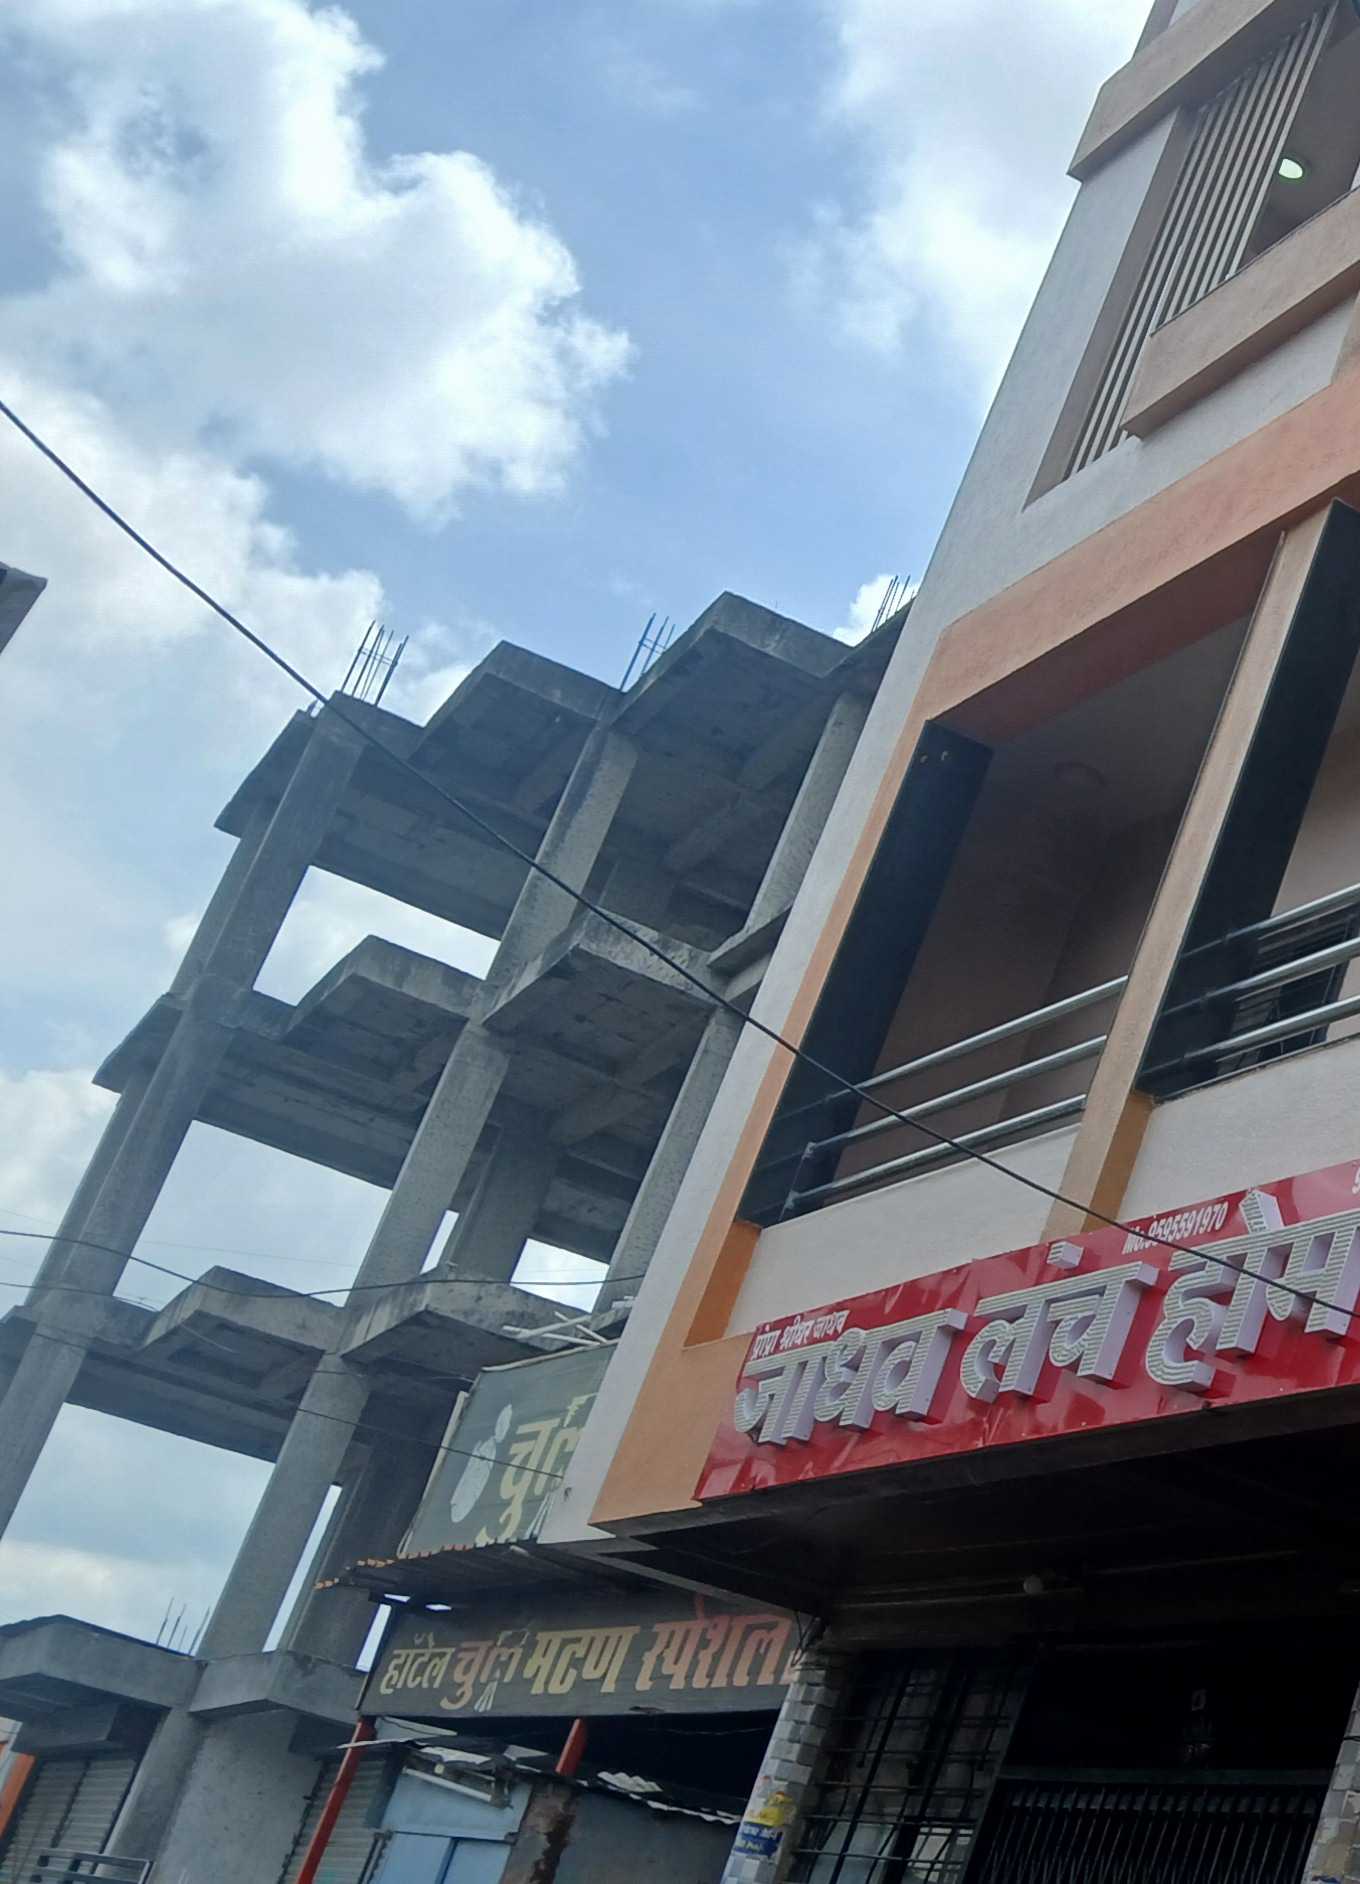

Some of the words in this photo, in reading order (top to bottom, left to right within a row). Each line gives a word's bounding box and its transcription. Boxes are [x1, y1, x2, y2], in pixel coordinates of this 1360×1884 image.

[734, 1308, 969, 1447] जाधव
[960, 1241, 1159, 1404] लंच
[380, 1632, 456, 1695] हॉटेल
[522, 1625, 641, 1695] मटण
